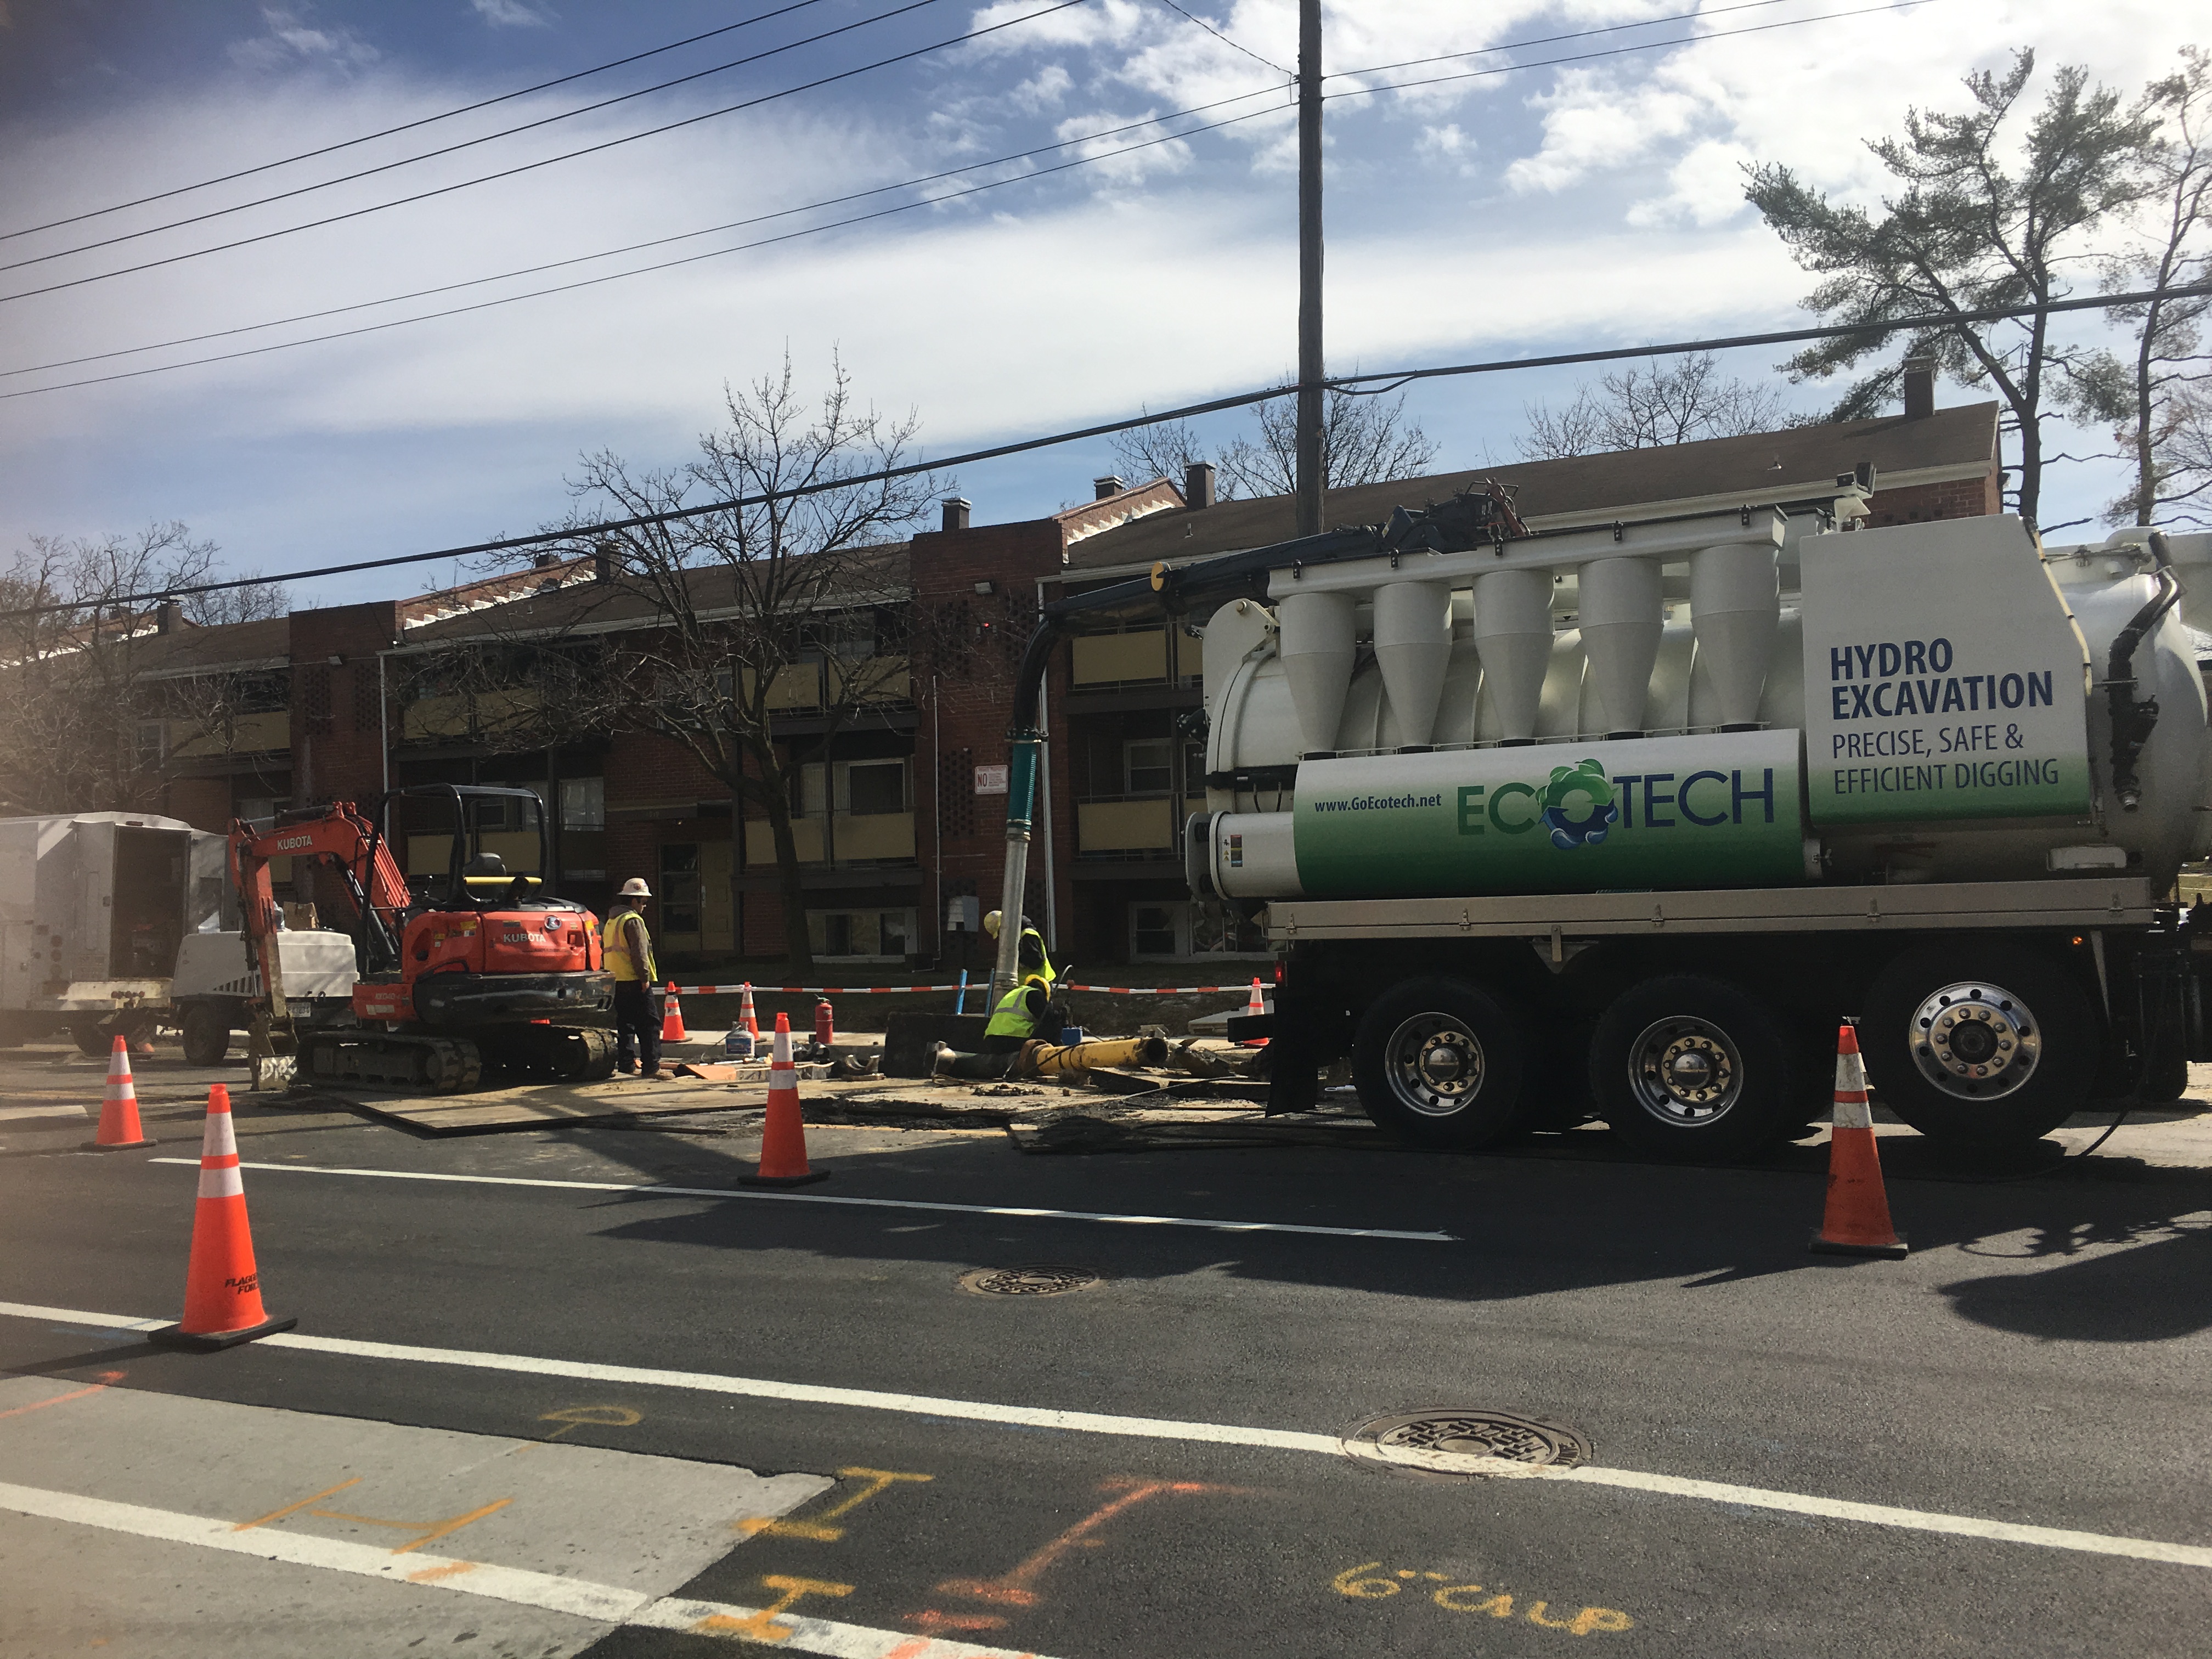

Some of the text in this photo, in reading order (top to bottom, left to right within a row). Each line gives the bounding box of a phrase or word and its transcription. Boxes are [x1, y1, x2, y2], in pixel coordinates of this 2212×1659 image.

[1830, 637, 1954, 681] HYDRO
[1832, 670, 2053, 720] EXCAVATION
[1833, 723, 2025, 759] PRECISE, SAFE &
[978, 773, 988, 787] NO
[1834, 758, 2059, 794] EFFICIENT DIGGING
[1314, 793, 1442, 812] www.GoEcotech.net
[1457, 761, 1775, 845] ECOTECH
[277, 834, 313, 850] KUBOTA
[503, 933, 546, 943] KUBOTA
